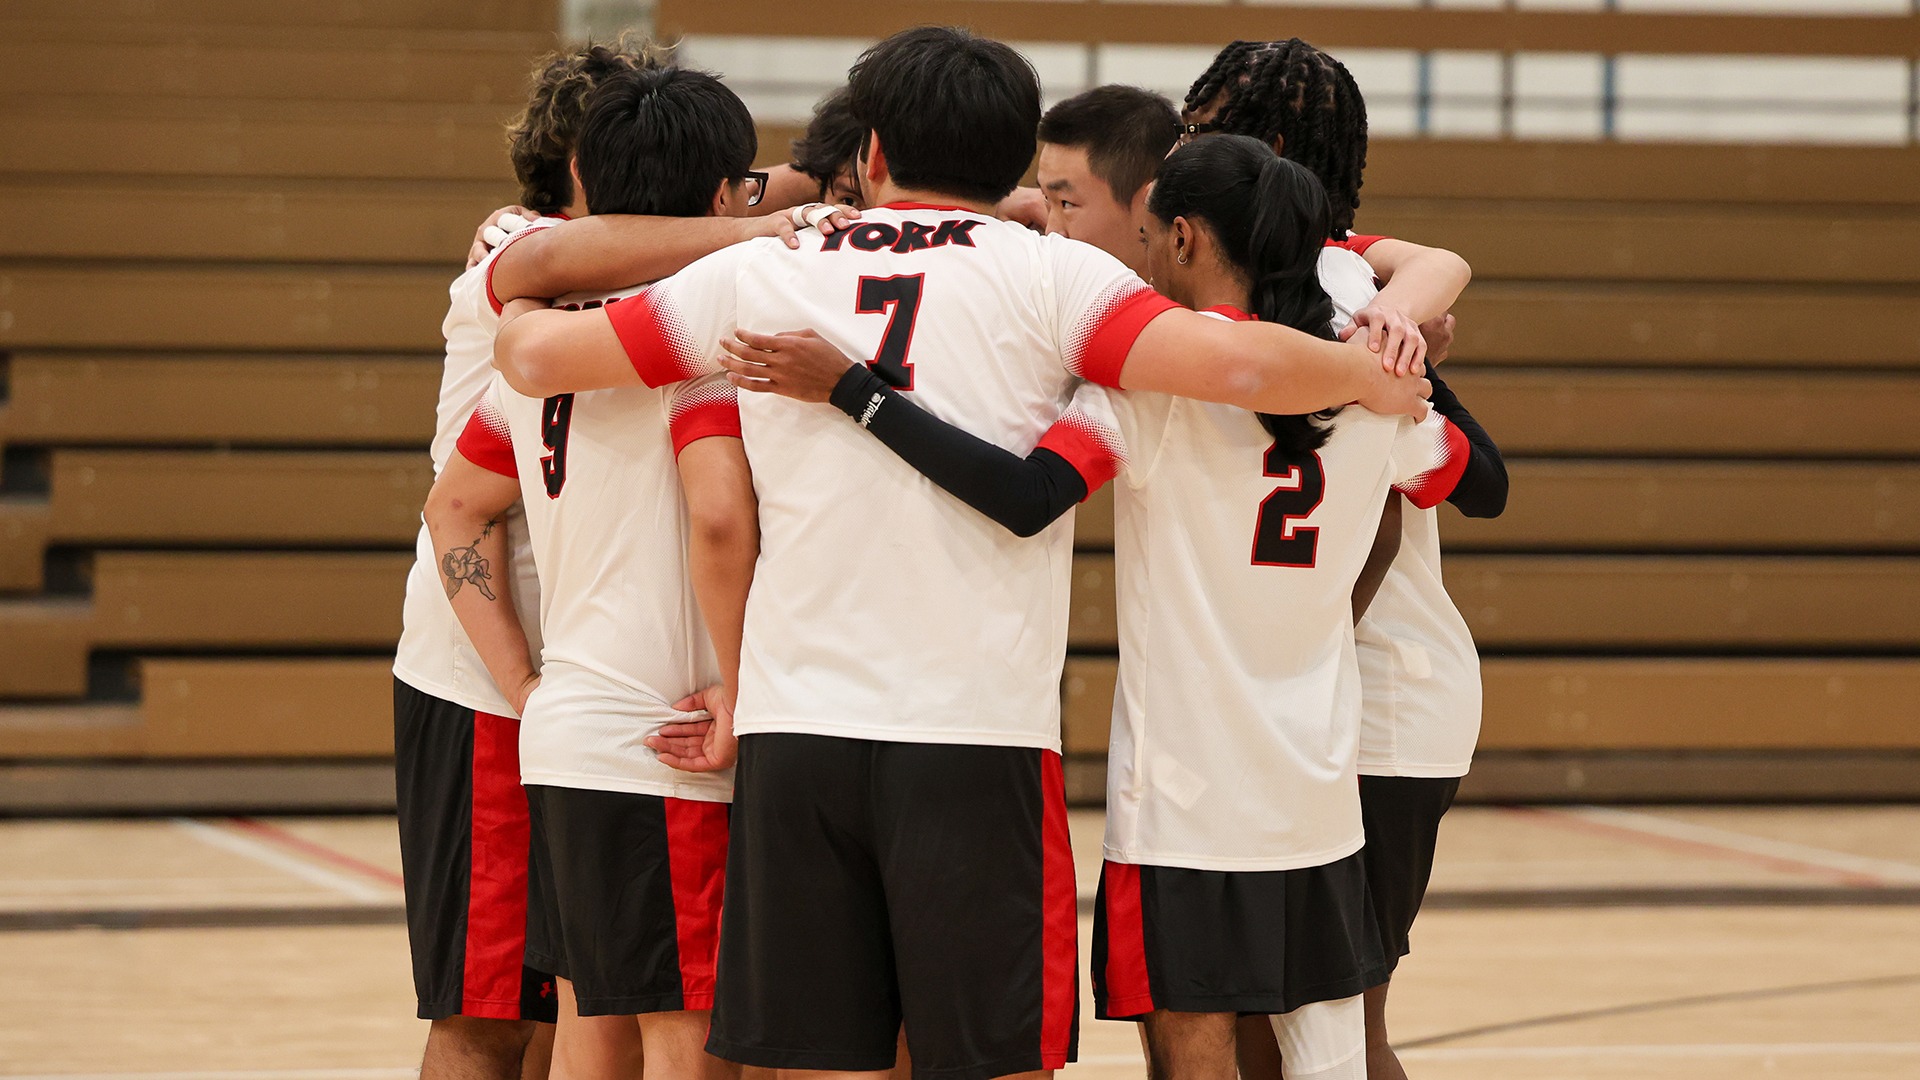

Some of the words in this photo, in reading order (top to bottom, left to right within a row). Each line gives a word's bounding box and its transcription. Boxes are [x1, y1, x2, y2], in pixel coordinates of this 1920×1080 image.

[820, 220, 987, 254] YORK
[855, 272, 926, 392] 7
[539, 392, 576, 500] 9
[1251, 440, 1326, 569] 2
